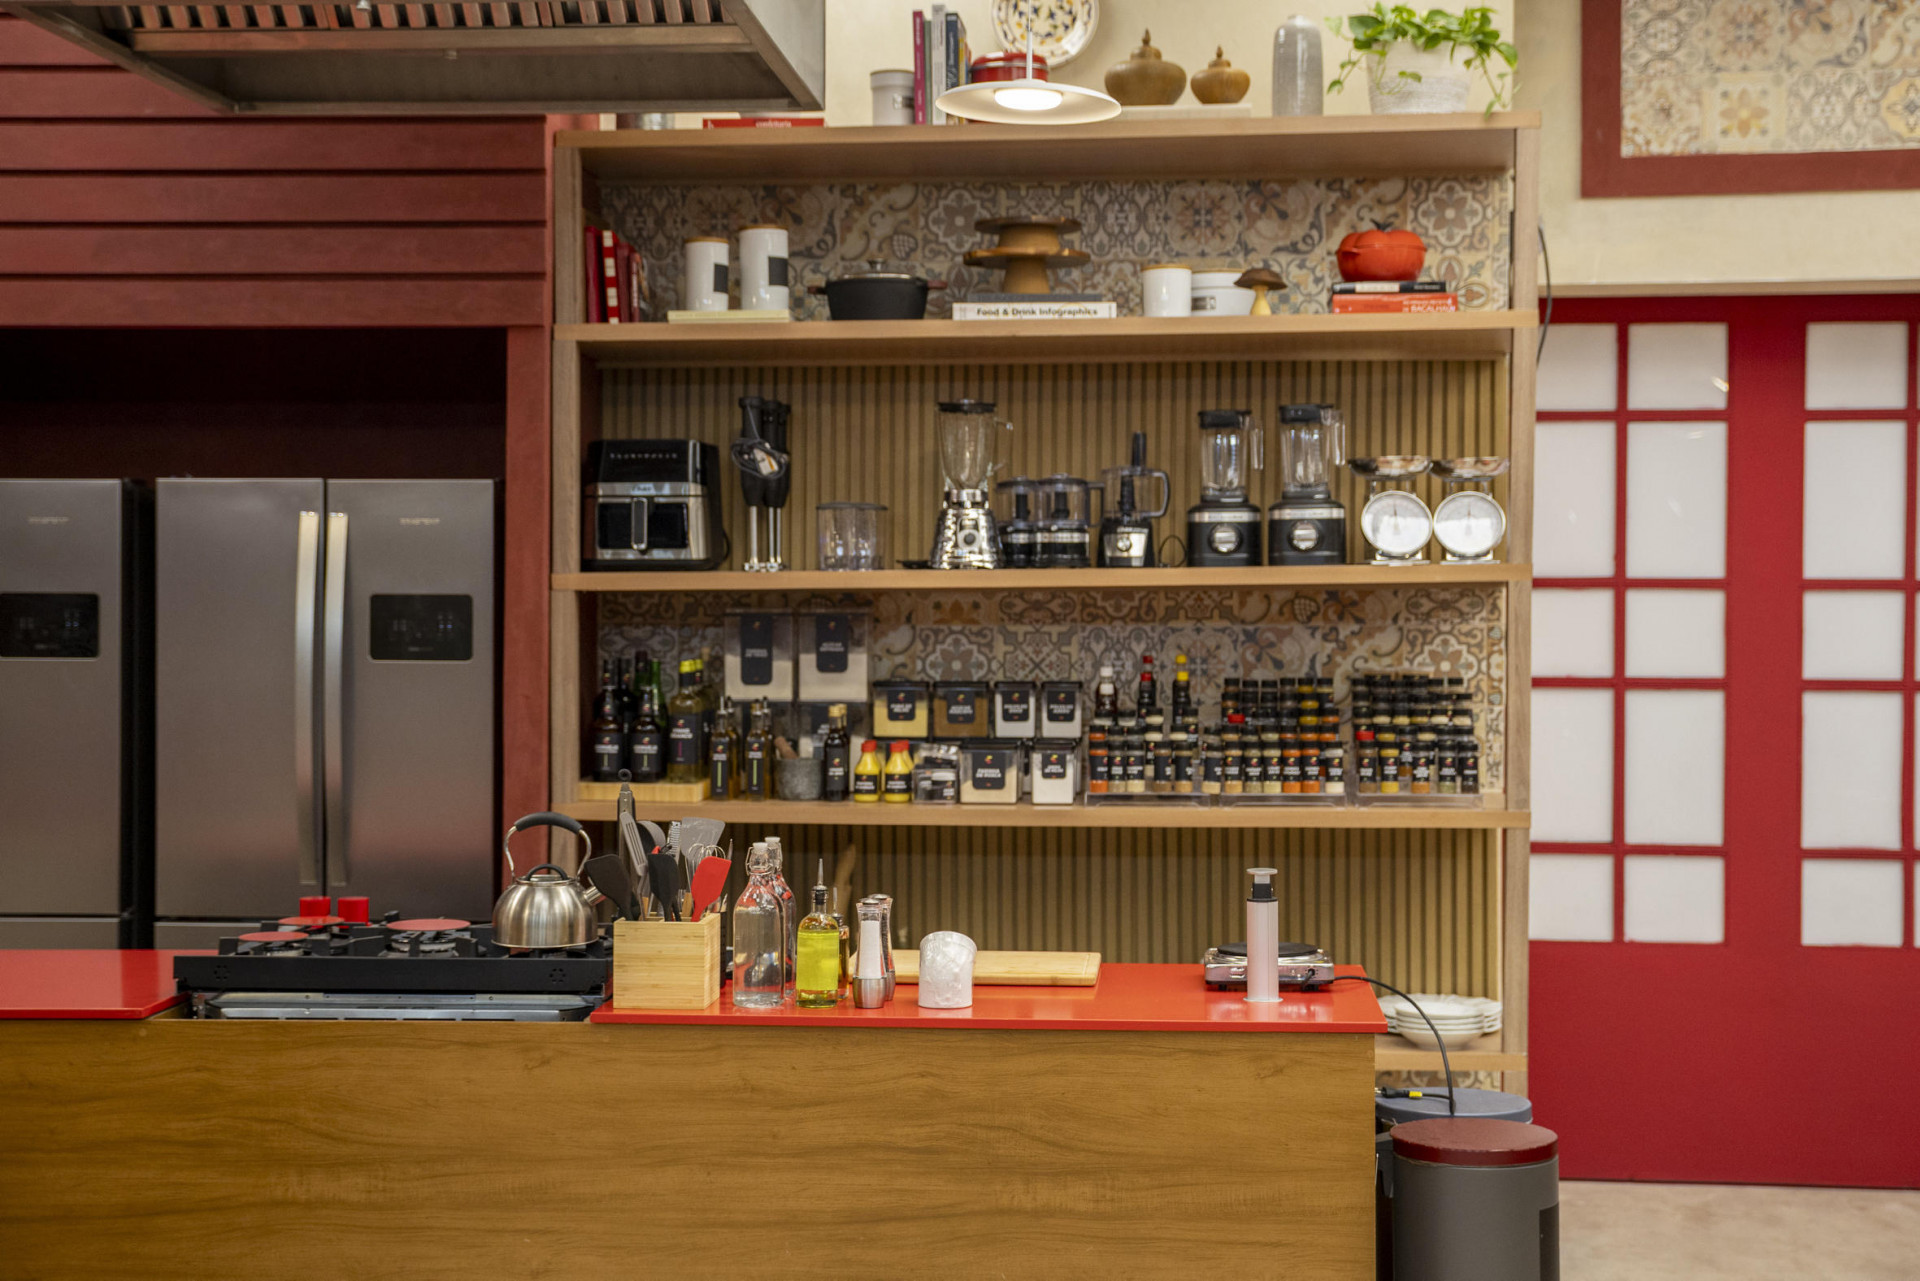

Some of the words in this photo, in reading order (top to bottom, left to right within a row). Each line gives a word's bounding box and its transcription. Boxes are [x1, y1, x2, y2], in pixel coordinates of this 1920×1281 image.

[976, 307, 1000, 316] Food
[1003, 308, 1009, 316] &
[1012, 307, 1037, 316] Drink
[1039, 307, 1099, 317] Infographics
